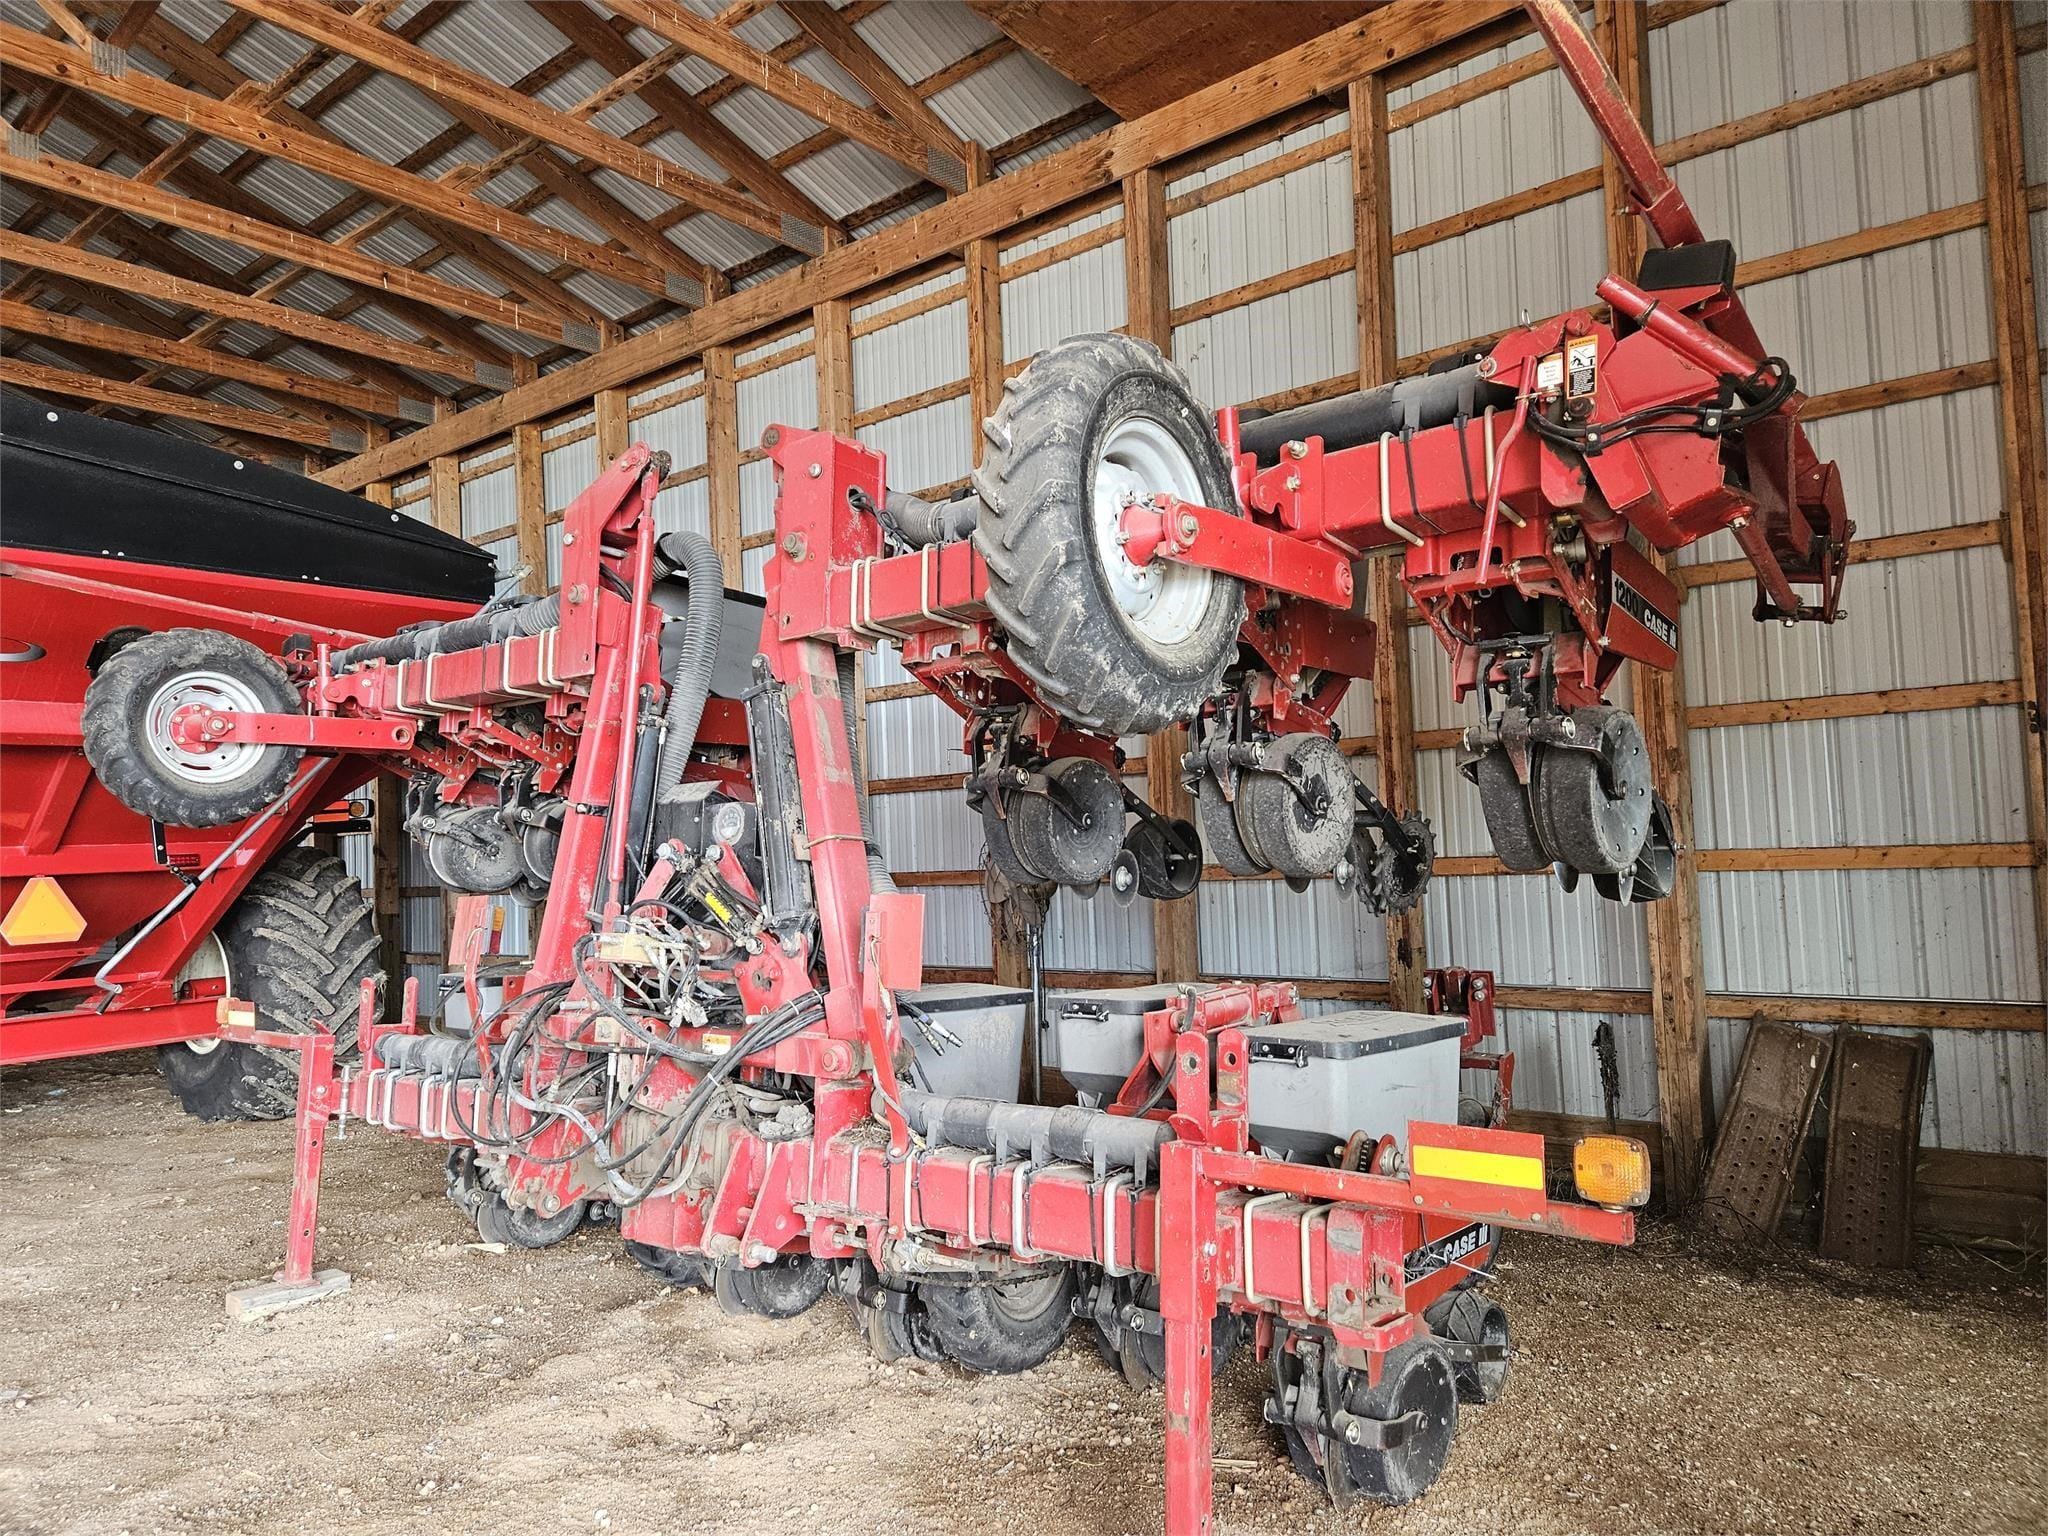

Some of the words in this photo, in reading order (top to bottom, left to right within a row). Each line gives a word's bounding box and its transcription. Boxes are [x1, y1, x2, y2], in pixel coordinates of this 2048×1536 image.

[1614, 577, 1639, 617] 1200
[1644, 608, 1669, 641] CASE
[1443, 1230, 1477, 1264] CASE
